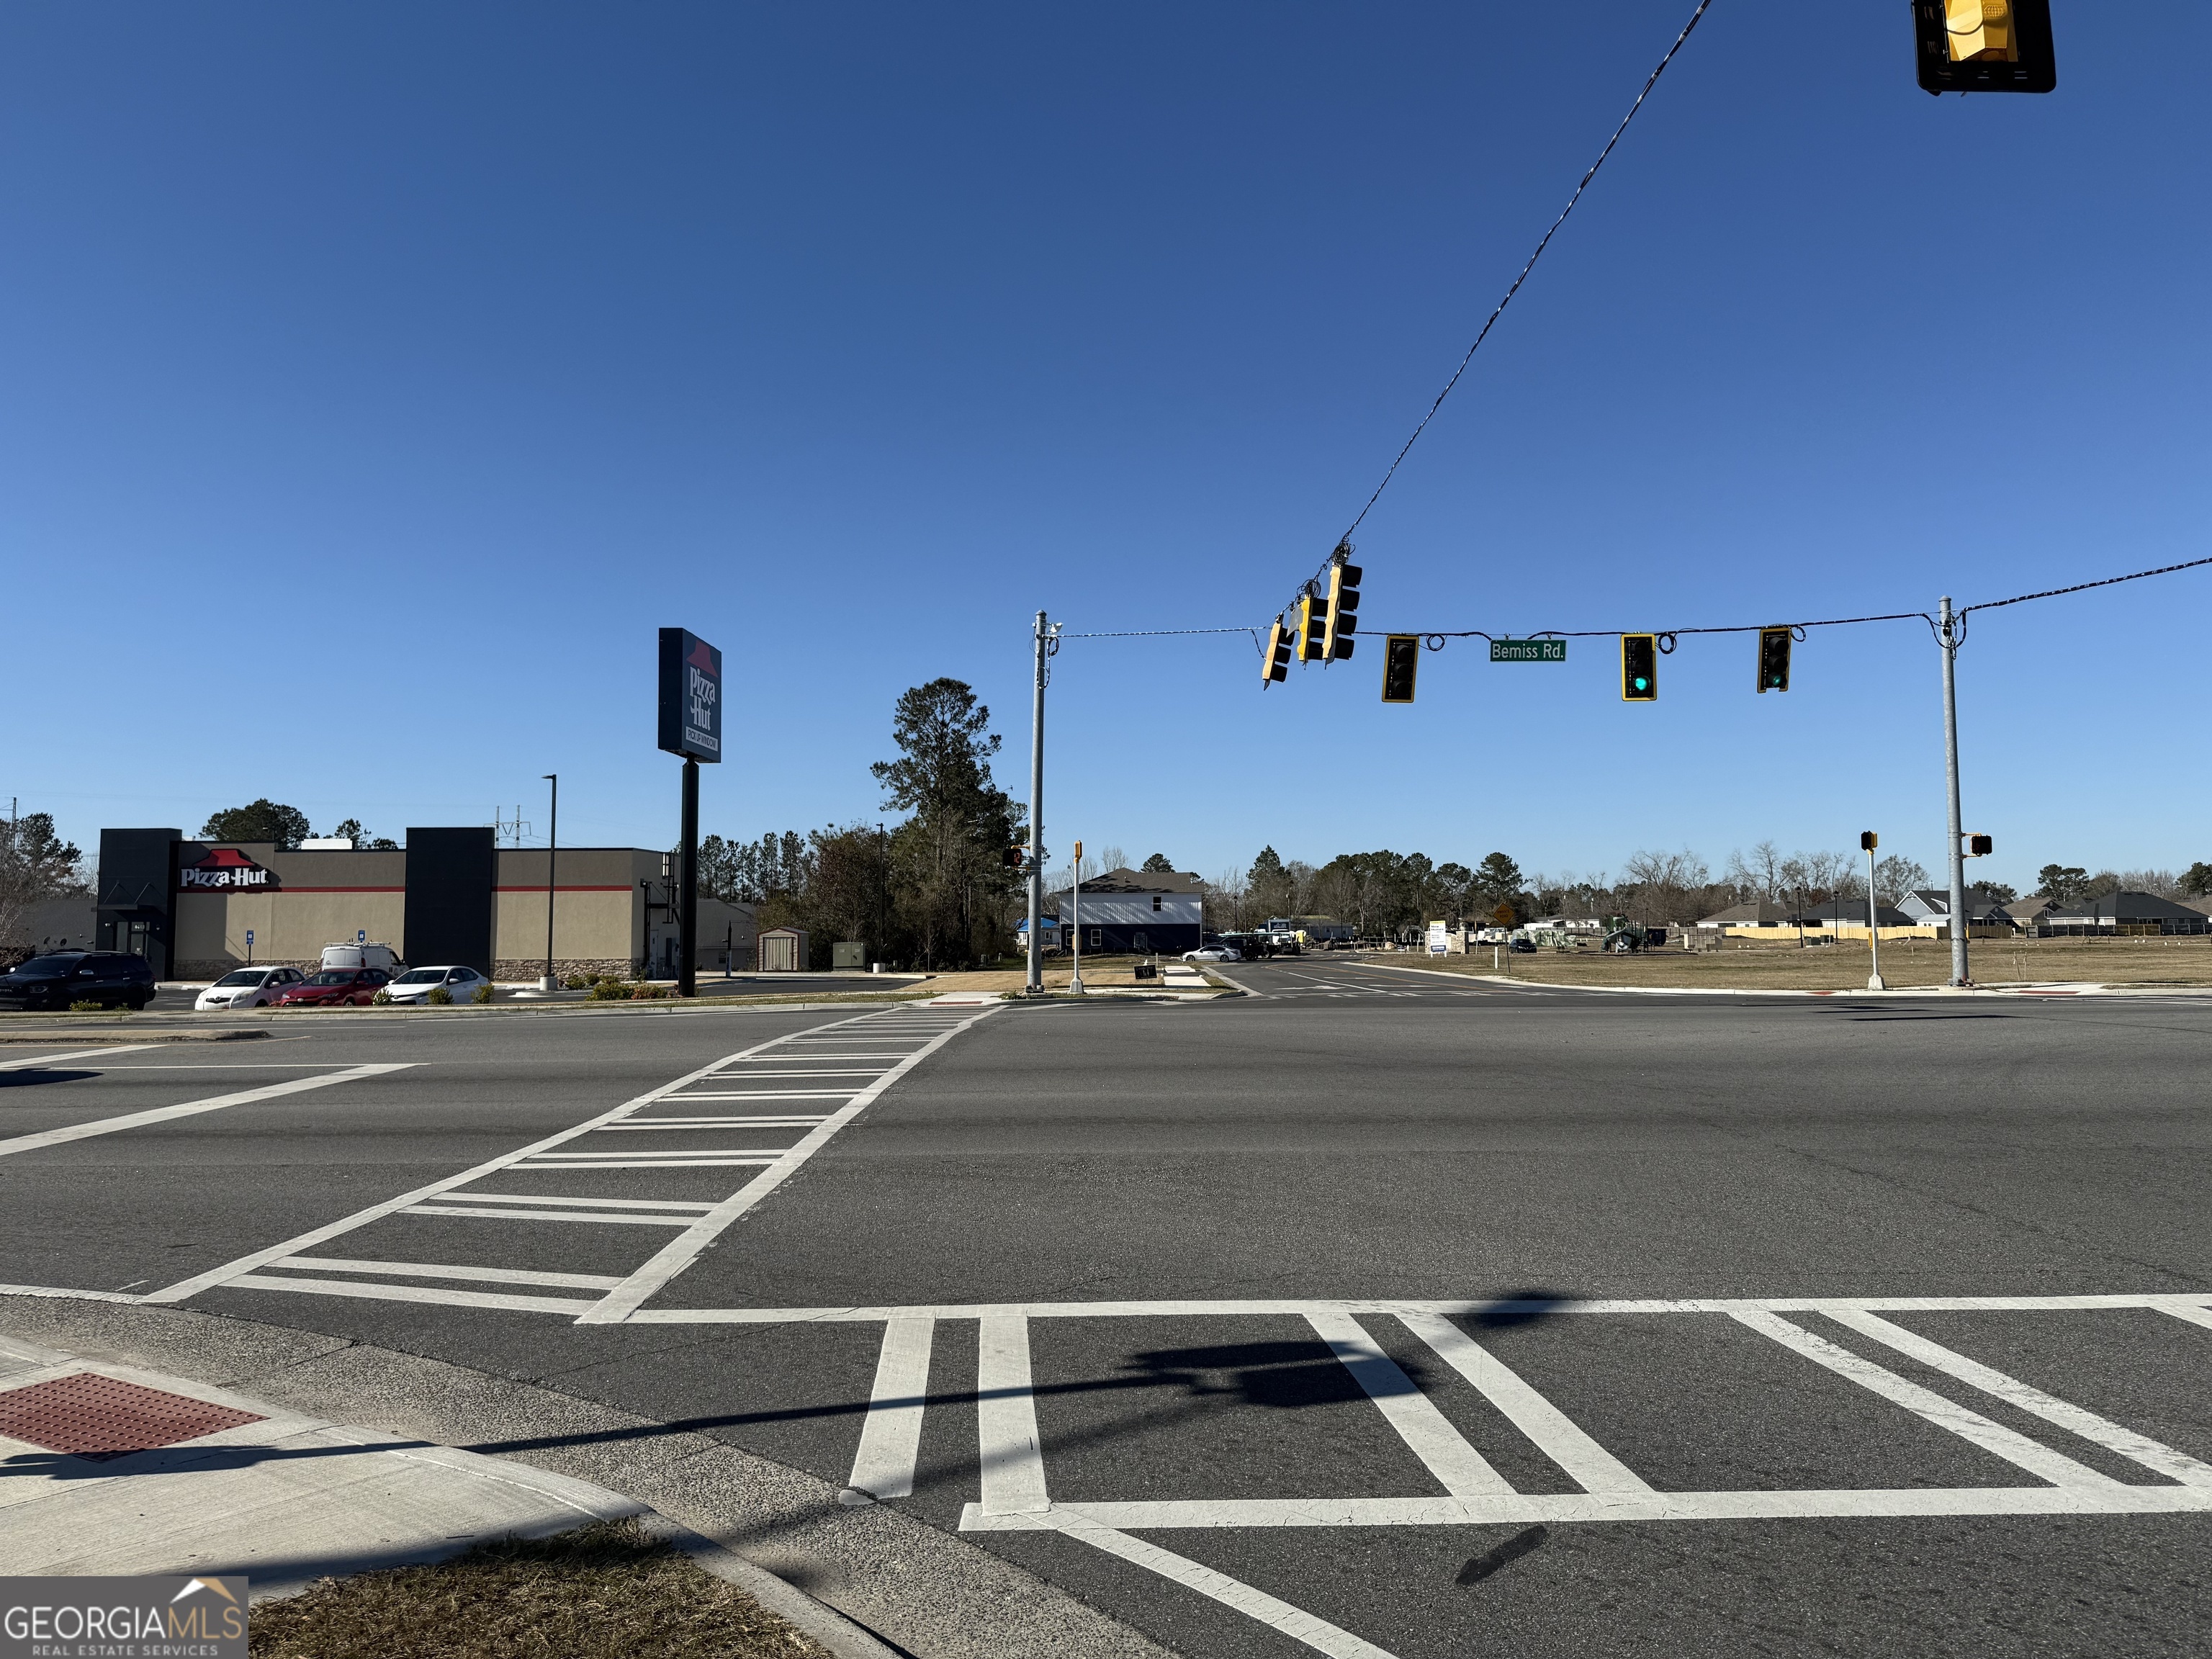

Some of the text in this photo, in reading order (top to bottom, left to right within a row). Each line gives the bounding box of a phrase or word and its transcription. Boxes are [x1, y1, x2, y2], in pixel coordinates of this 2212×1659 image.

[1492, 643, 1563, 658] Bemiss Rd.
[689, 666, 716, 705] Pizza
[690, 695, 711, 731] Hut
[688, 729, 716, 748] PICK UP WINDOW
[181, 868, 267, 887] Pizza Hut
